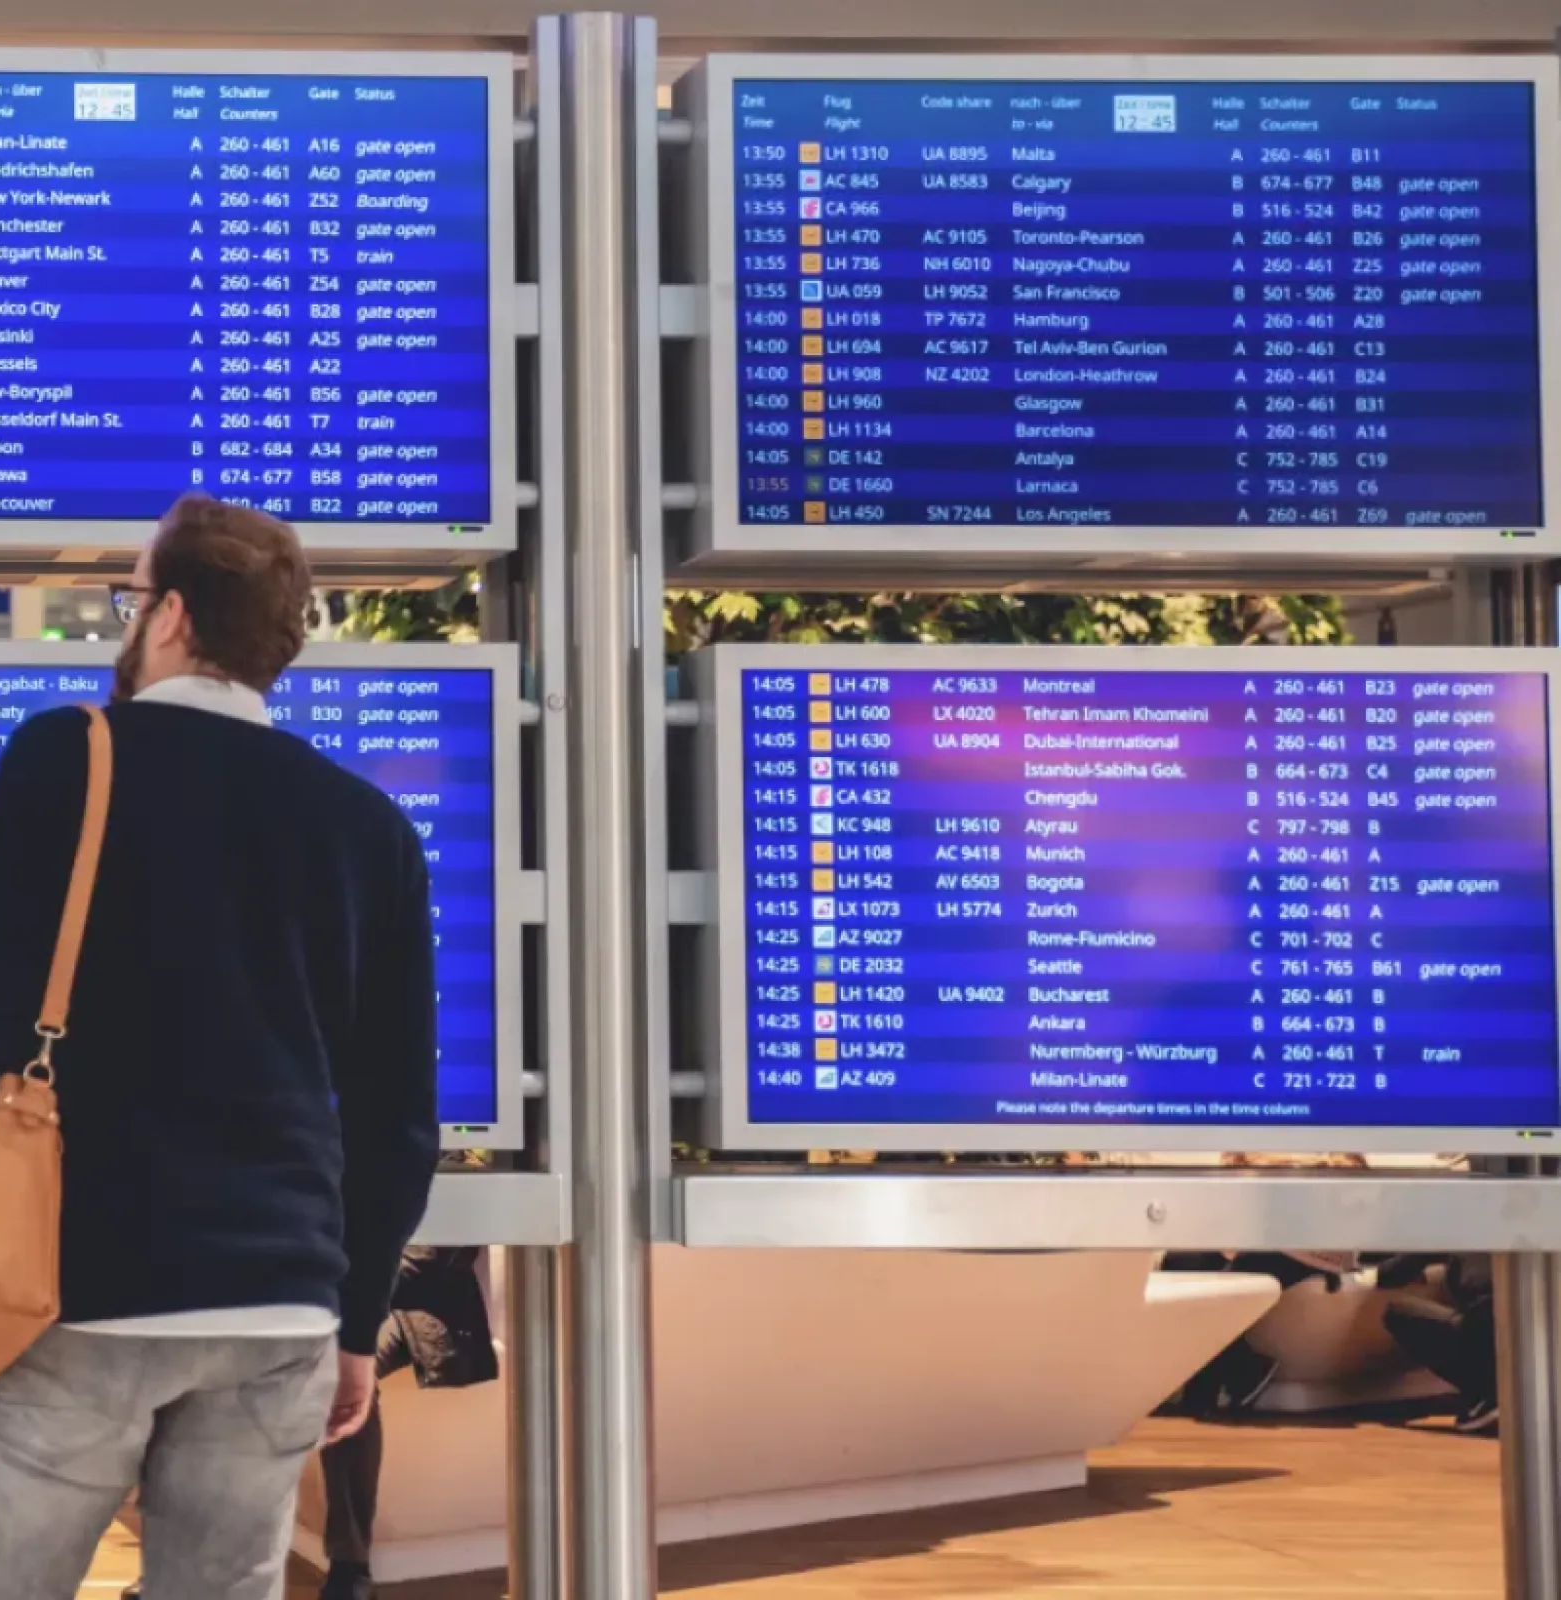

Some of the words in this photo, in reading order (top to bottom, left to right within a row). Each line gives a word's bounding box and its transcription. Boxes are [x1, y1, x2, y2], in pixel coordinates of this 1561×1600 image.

[172, 85, 206, 99] Halle
[219, 85, 270, 99] Schalter
[308, 85, 340, 100] Gate
[354, 87, 396, 101] Status
[173, 106, 199, 119] Hall
[219, 107, 279, 121] Counters
[307, 137, 340, 153] A16
[1011, 145, 1056, 161] Malta
[1011, 173, 1072, 194] Calgary
[9, 189, 112, 206] York-Newark
[1012, 200, 1067, 221] Beijing
[744, 227, 786, 243] 13:55
[1011, 229, 1145, 245] Toronto-Pearson
[44, 245, 85, 261] Main
[86, 245, 108, 261] St.
[356, 248, 394, 264] train
[1012, 256, 1130, 277] Nagoya-Chubu
[1012, 284, 1042, 300] San
[1045, 283, 1120, 301] Francisco
[1400, 287, 1436, 305] gate
[1439, 289, 1482, 305] open
[30, 300, 61, 320] City
[1013, 311, 1090, 332] Hamburg
[1012, 339, 1032, 355] Tel
[1035, 340, 1109, 355] Aviv-Ben
[1112, 340, 1167, 356] Gurion
[1014, 366, 1158, 384] London-Heathrow
[1014, 393, 1083, 415] Glasgow
[60, 411, 100, 428] Main
[102, 412, 123, 428] St.
[1014, 421, 1095, 438] Barcelona
[1014, 449, 1074, 471] Antalya
[1015, 477, 1079, 494] Larnaca
[1016, 507, 1040, 521] Los
[1044, 507, 1111, 524] Angeles
[58, 676, 99, 692] Baku
[1022, 676, 1096, 694] Montreal
[1022, 705, 1079, 721] Tehran
[1082, 705, 1130, 722] Imam
[1133, 705, 1209, 723] Khomeini
[1023, 733, 1180, 752] Dubai-International
[1023, 760, 1148, 778] Istanbul-Sabiha
[1152, 761, 1188, 779] Gok.
[754, 787, 797, 804] 14:15
[1023, 787, 1099, 811] Chengdu
[1414, 793, 1450, 812] gate
[1456, 795, 1497, 811] open
[1023, 817, 1079, 840] Atyrau
[1025, 844, 1086, 863] Munich
[1025, 873, 1085, 894] Bogota
[1025, 900, 1079, 918] Zurich
[1026, 929, 1157, 947] Rome-Fiumicino
[1027, 957, 1083, 975] Seattle
[1027, 986, 1110, 1003] Bucharest
[1027, 1014, 1086, 1031] Ankara
[1029, 1070, 1129, 1088] Milan-Linate
[996, 1099, 1036, 1114] Please
[1041, 1101, 1067, 1114] note
[1070, 1100, 1089, 1114] the
[1093, 1100, 1153, 1118] departure
[1156, 1102, 1192, 1115] times
[1194, 1102, 1206, 1114] in
[1209, 1101, 1229, 1115] the
[1232, 1102, 1259, 1116] time
[1264, 1102, 1311, 1116] column
